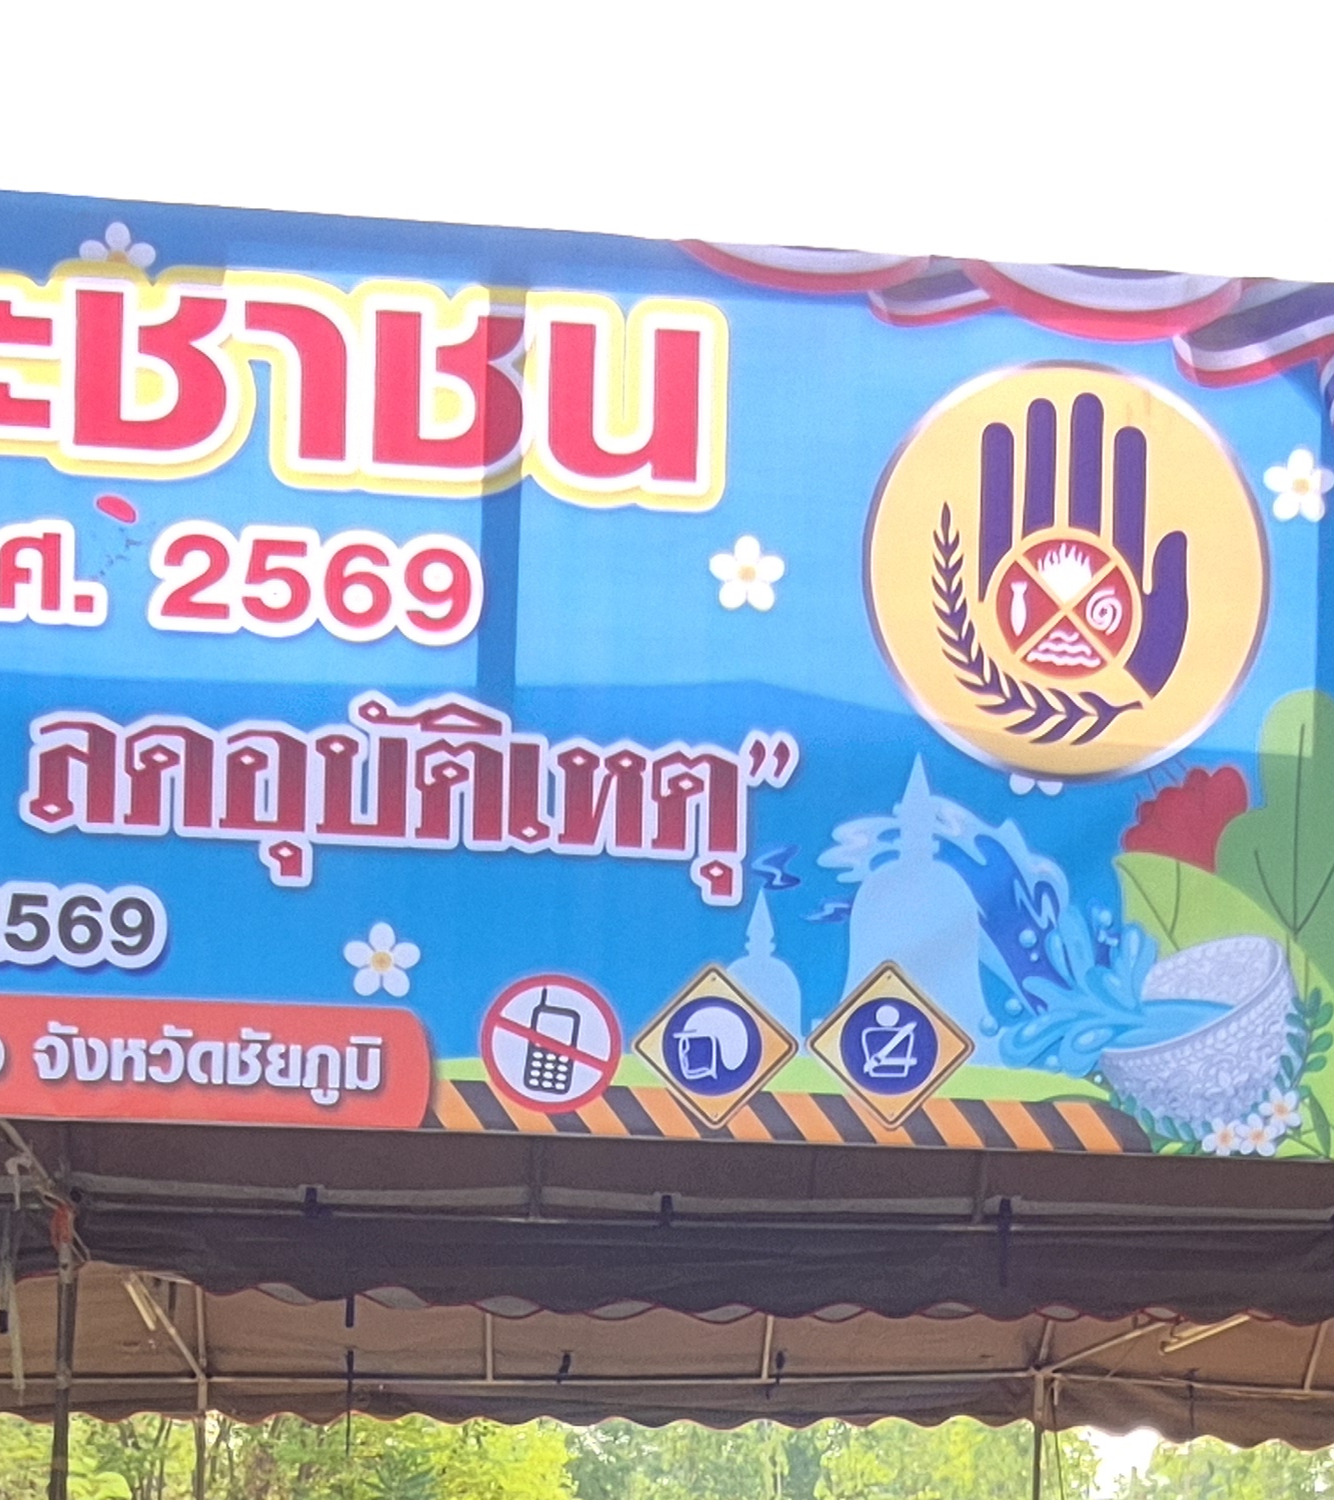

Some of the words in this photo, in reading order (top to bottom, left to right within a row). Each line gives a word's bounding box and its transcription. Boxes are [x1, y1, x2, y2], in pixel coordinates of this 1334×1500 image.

[163, 534, 472, 632] 2569
[32, 1021, 382, 1107] จังหวัดชัยภูมิ
